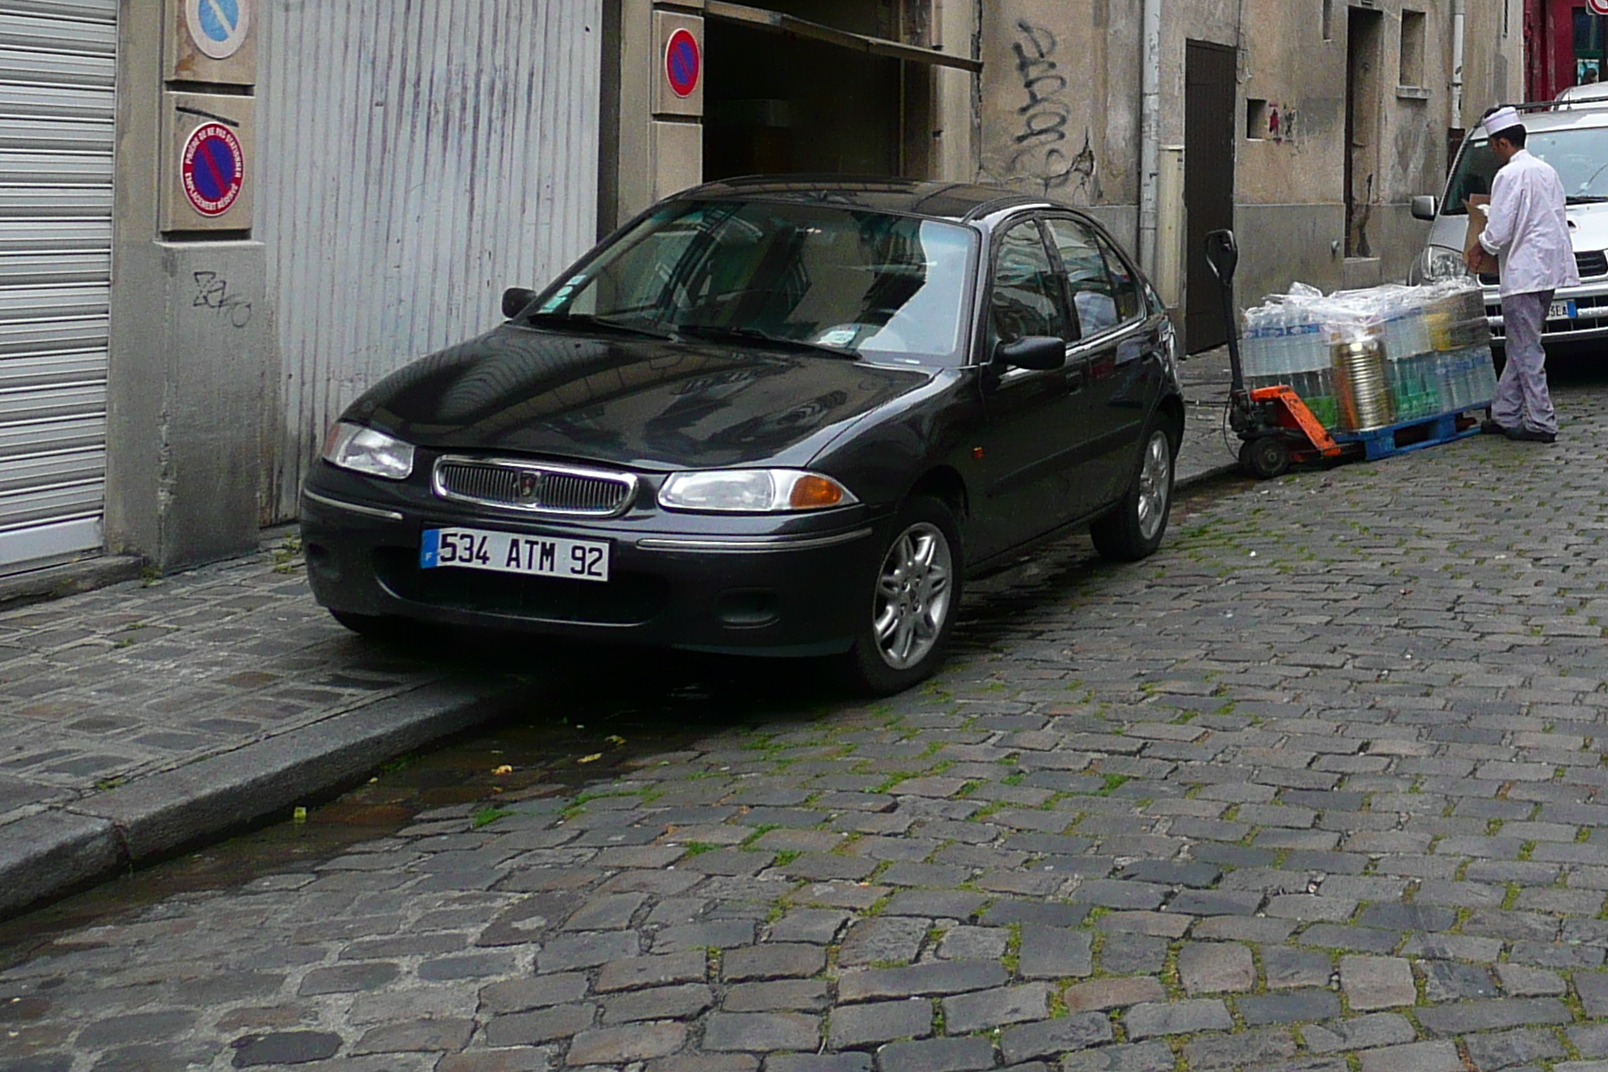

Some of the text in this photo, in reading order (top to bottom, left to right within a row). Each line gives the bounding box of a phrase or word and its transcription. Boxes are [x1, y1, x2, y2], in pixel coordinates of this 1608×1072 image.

[440, 532, 490, 564] 534
[506, 539, 556, 572] ATM
[570, 545, 604, 577] 92
